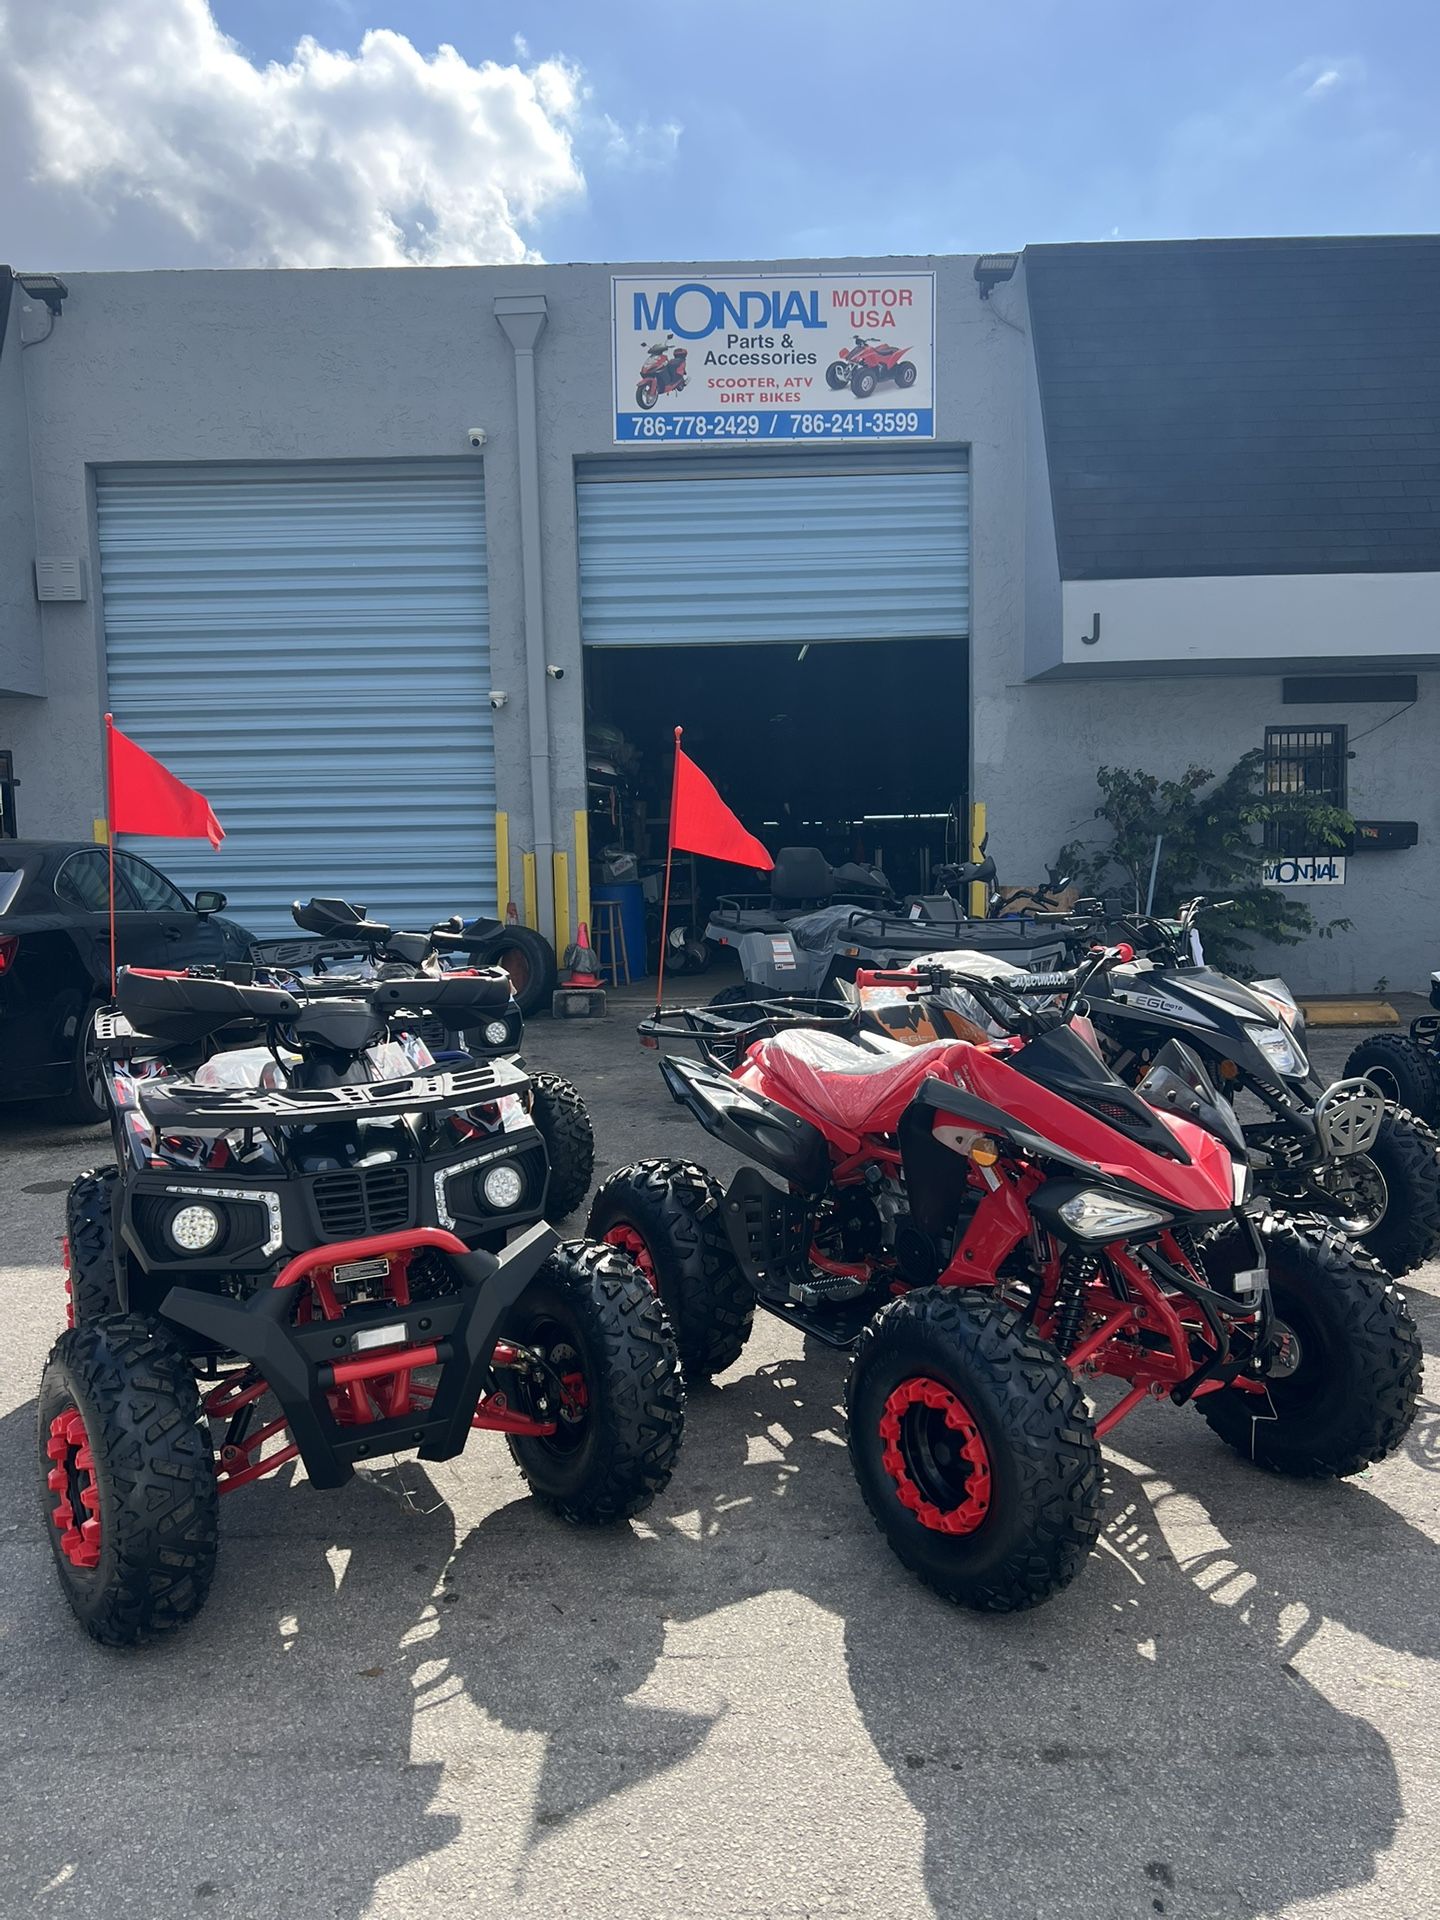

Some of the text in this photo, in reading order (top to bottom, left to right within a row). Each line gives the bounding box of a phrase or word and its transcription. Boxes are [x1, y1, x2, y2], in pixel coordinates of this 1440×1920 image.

[832, 289, 913, 307] MOTOR
[632, 283, 828, 340] MONDIAL
[850, 311, 896, 328] USA
[727, 334, 794, 349] Parts &
[704, 350, 817, 366] Accessories
[707, 377, 813, 389] SCOOTER, ATV
[720, 391, 801, 403] DIRT BIKES
[631, 415, 759, 437] 786-778-2429
[790, 412, 918, 434] 786-241-3599
[1081, 613, 1100, 645] J
[1264, 862, 1339, 883] MONDIAL
[1136, 996, 1171, 1011] EGL
